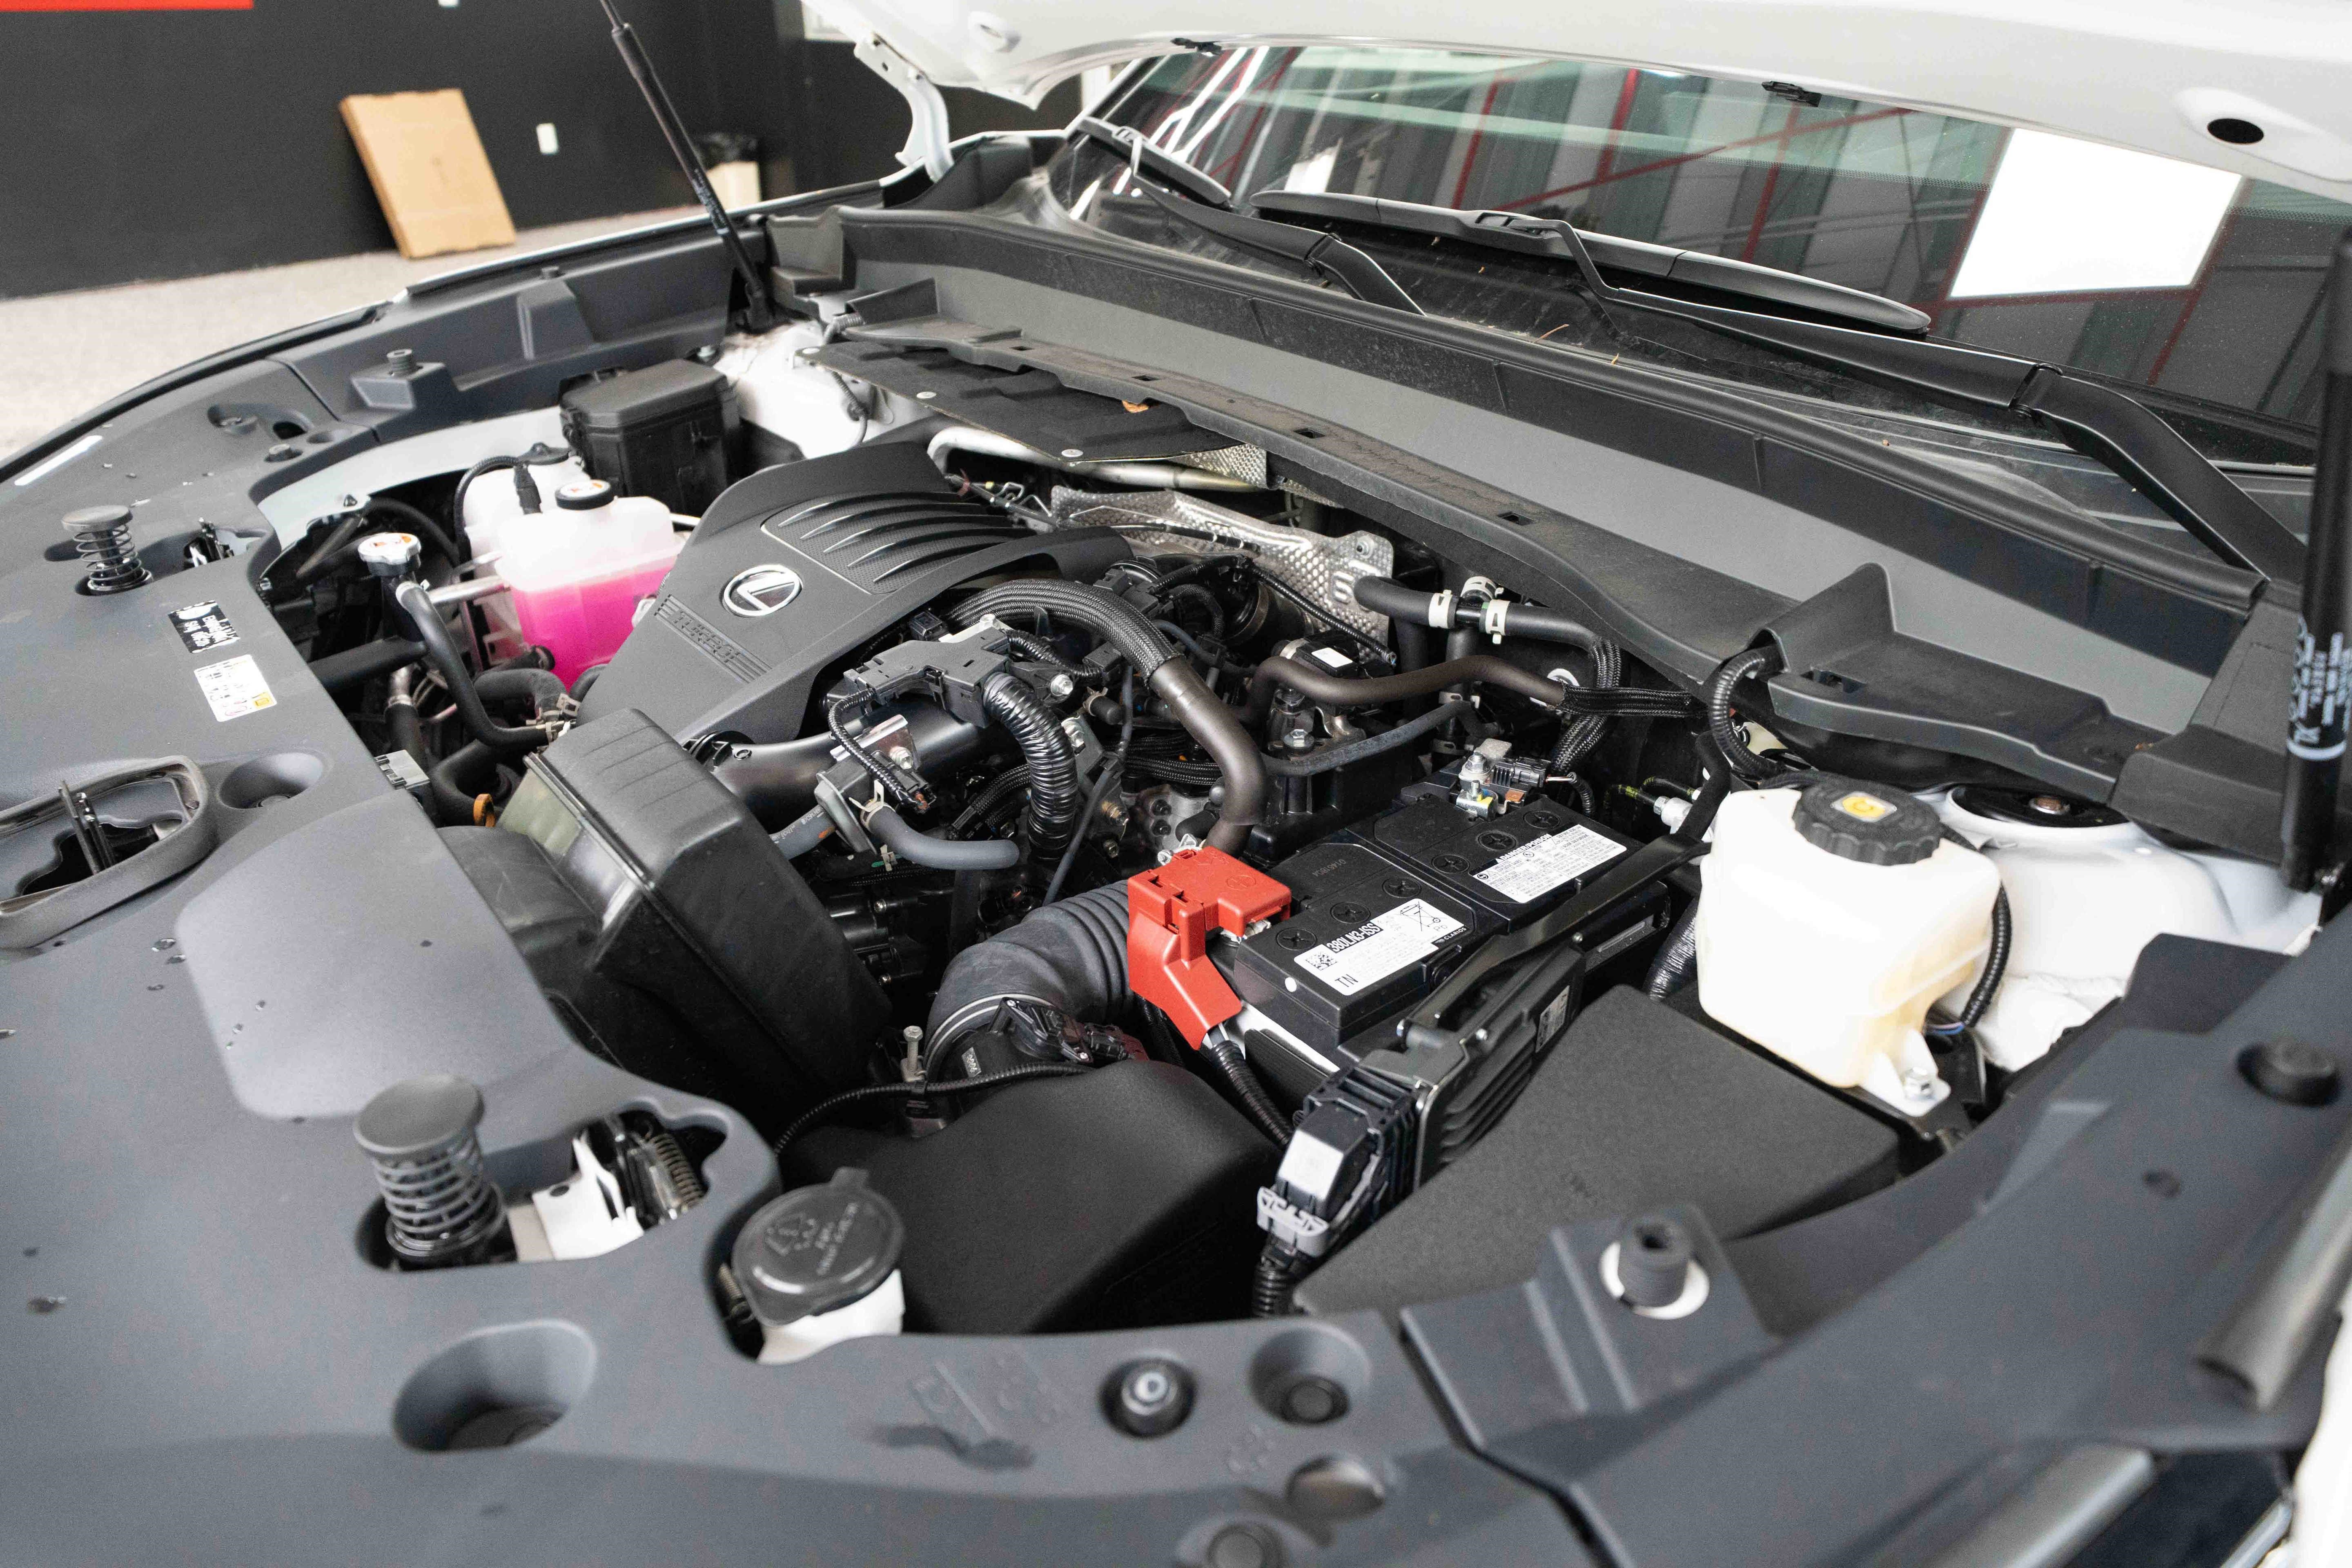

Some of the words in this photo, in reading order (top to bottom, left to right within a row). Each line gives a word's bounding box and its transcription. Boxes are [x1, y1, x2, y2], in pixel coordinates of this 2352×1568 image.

[674, 611, 734, 662] TURBO
[1326, 923, 1381, 952] 380LN3-ISS
[1444, 927, 1466, 940] CLARIOS
[1334, 974, 1359, 987] TN
